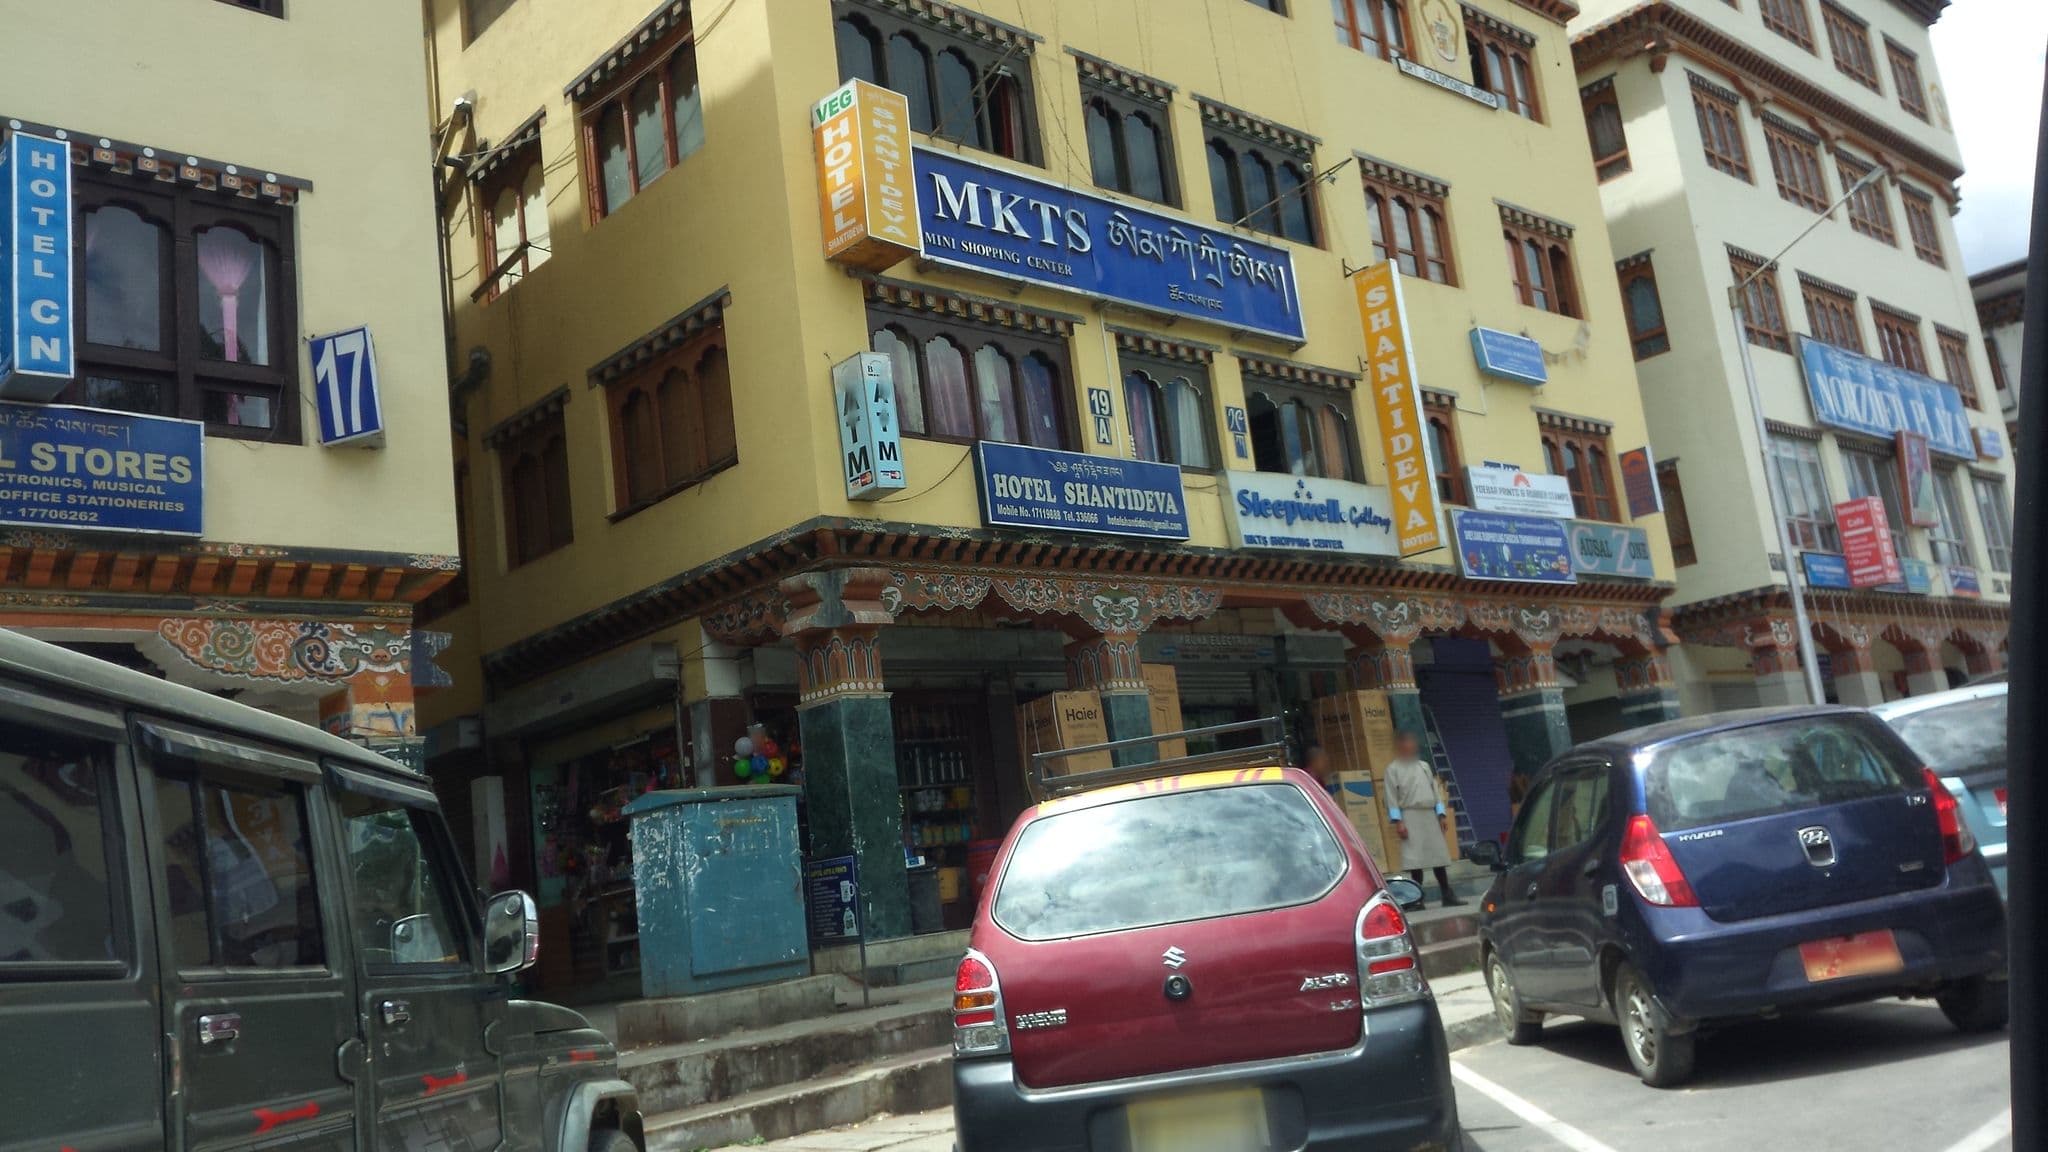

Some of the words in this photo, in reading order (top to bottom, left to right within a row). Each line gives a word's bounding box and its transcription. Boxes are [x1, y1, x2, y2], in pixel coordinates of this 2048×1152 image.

[815, 89, 852, 123] VEG
[822, 117, 857, 234] HOTEL
[872, 106, 908, 239] SHANTIDEVA
[30, 150, 57, 279] HOTEL
[929, 172, 1092, 253] MKTS
[925, 231, 957, 250] MINI
[961, 240, 1020, 264] SHOPPING
[1026, 255, 1073, 276] CENTER
[315, 332, 366, 438] 17
[1090, 388, 1109, 415] 19
[1364, 285, 1429, 531] SHANTIDEVA
[1098, 424, 1110, 444] A
[31, 442, 193, 485] STORES
[0, 490, 62, 504] OFFICE
[66, 494, 185, 513] STATIONERIES
[92, 480, 166, 496] MUSICAL
[992, 473, 1057, 504] HOTEL
[1063, 481, 1179, 515] SHANTIDEVA
[17, 507, 99, 522] 17706262
[996, 503, 1019, 516] Mobile
[1237, 488, 1343, 527] Sleepwell
[1349, 505, 1392, 535] Gallery
[1312, 538, 1344, 550] CENTER
[1401, 530, 1437, 550] HOTEL
[1065, 707, 1098, 722] Haier
[1678, 828, 1724, 842] HYUNDAI
[1299, 972, 1350, 992] ALTO
